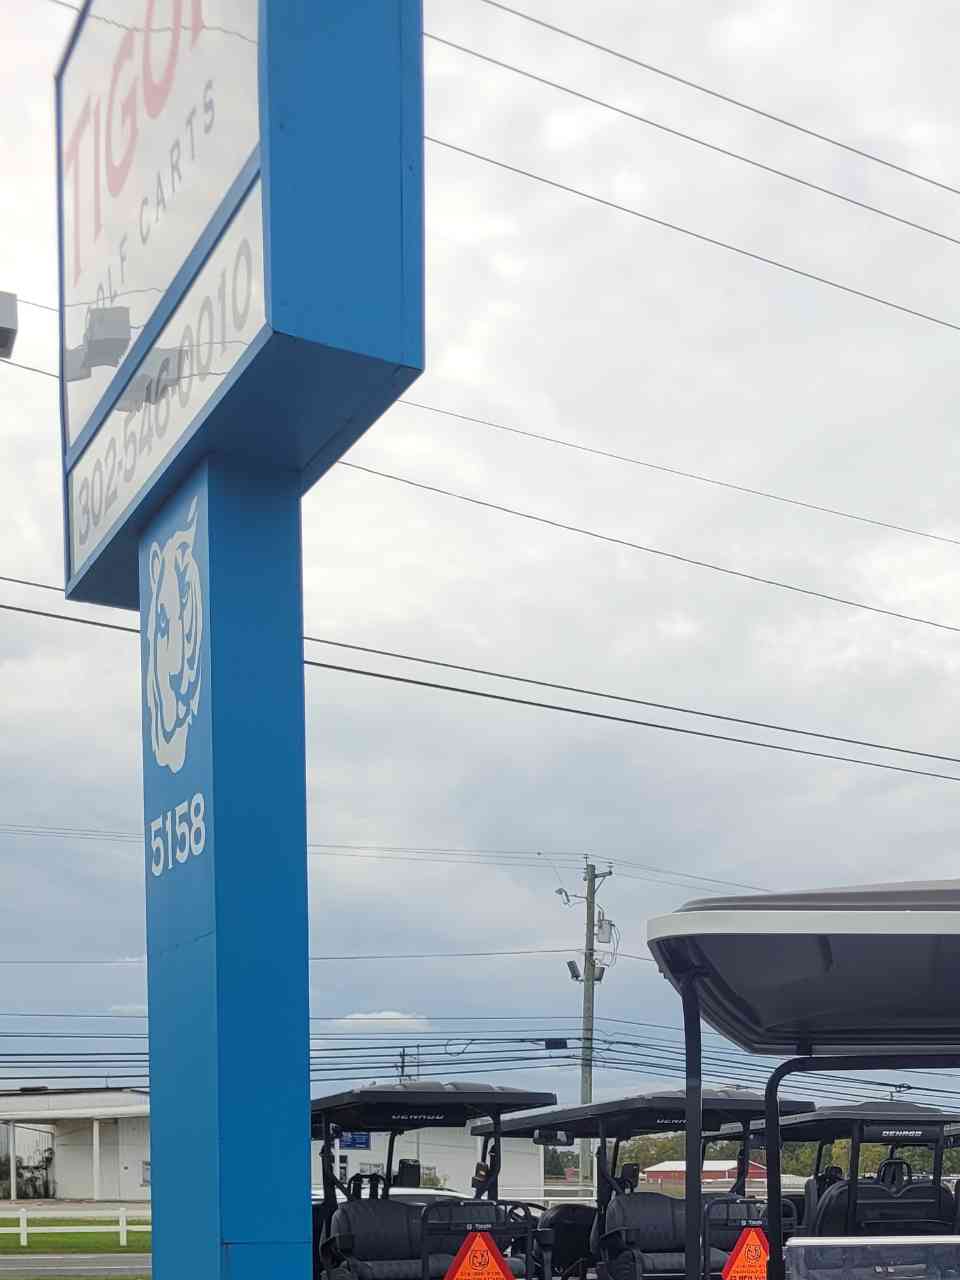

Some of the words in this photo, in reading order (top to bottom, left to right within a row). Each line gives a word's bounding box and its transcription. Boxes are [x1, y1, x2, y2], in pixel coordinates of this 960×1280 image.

[64, 0, 207, 289] TIGO
[139, 79, 215, 245] CARTS
[151, 792, 206, 877] 5158
